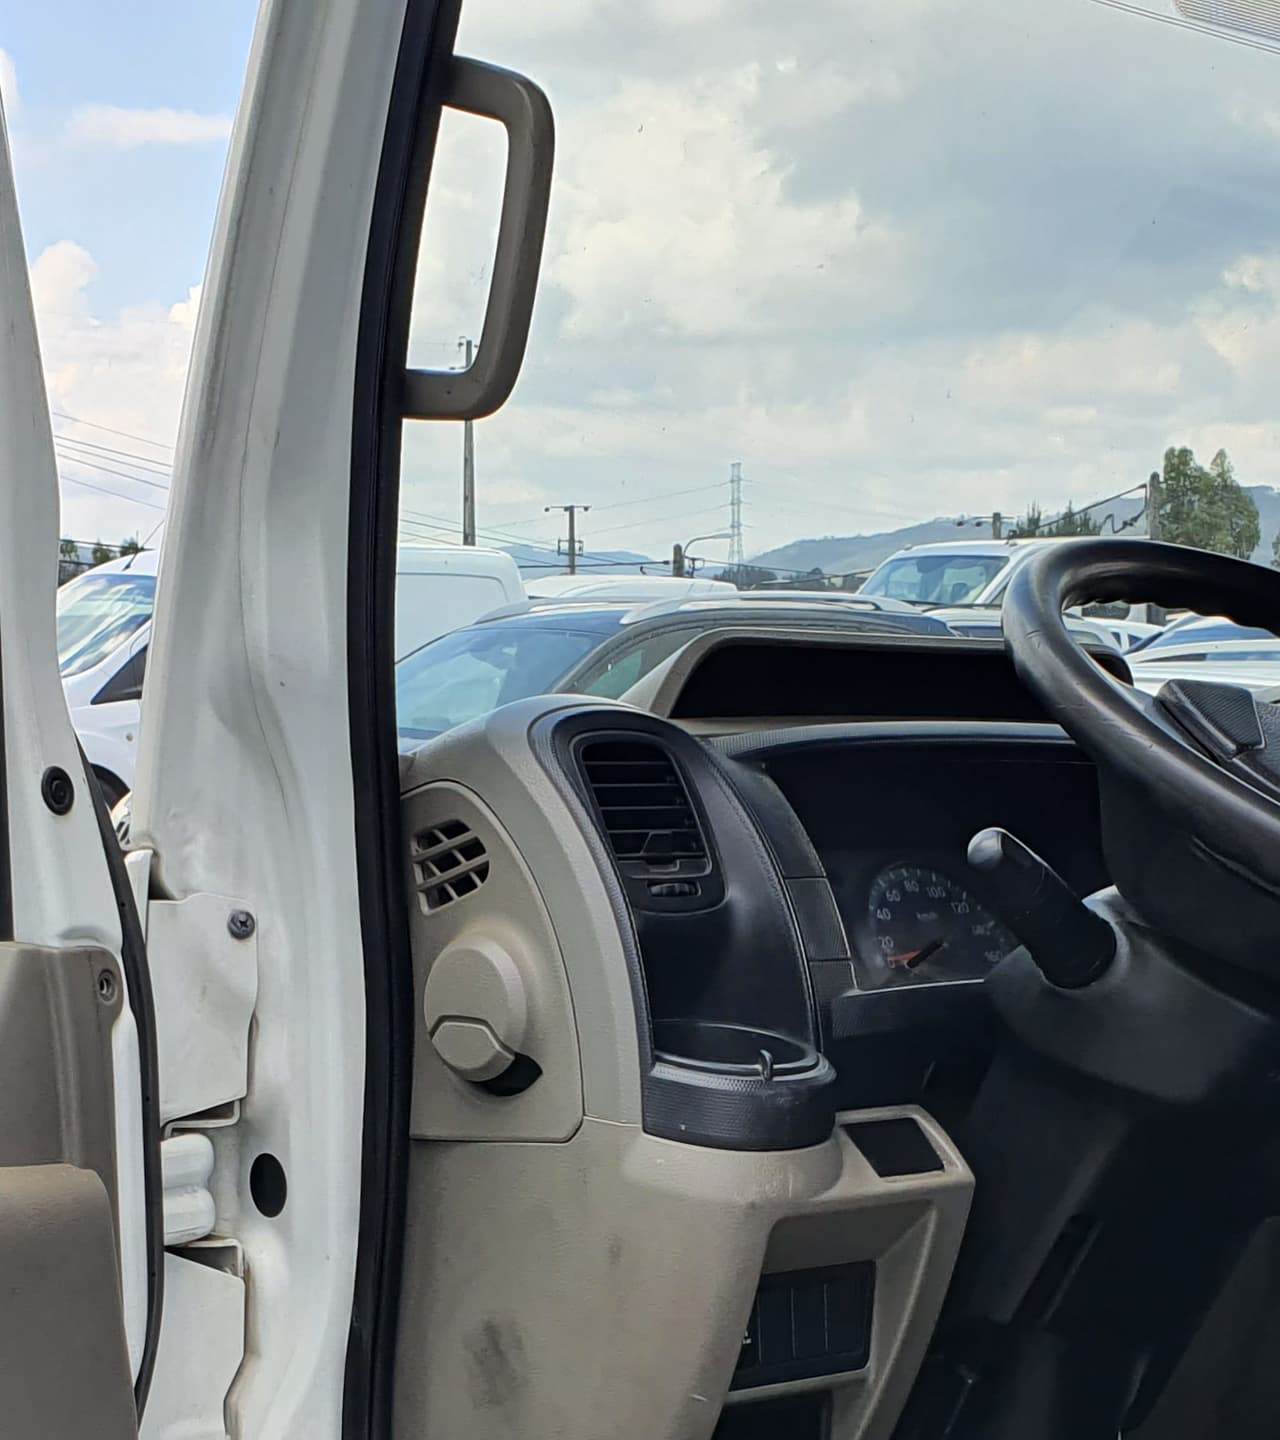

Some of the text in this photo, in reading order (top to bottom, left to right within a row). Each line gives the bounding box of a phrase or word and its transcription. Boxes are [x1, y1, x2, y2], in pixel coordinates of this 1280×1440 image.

[885, 889, 901, 902] 60
[926, 887, 946, 899] 100
[876, 907, 891, 921] 40
